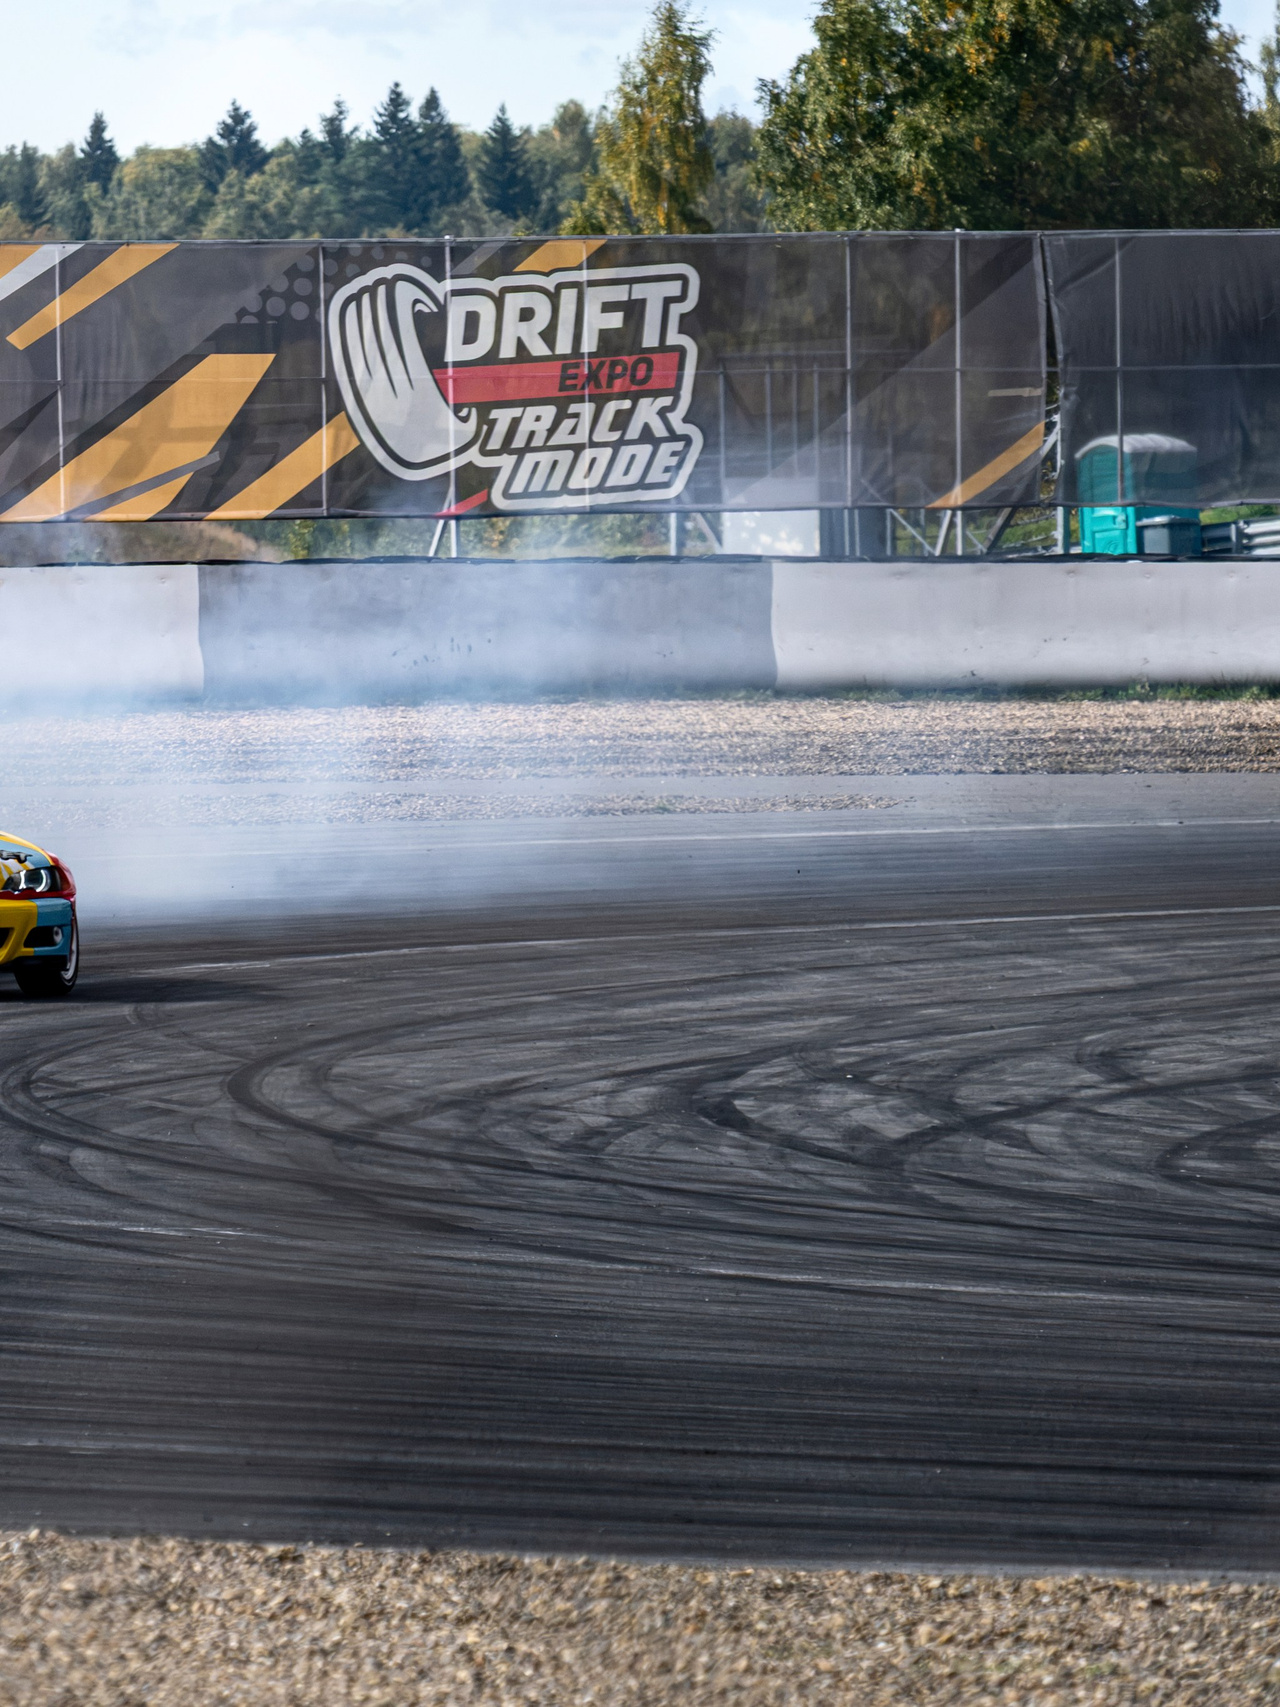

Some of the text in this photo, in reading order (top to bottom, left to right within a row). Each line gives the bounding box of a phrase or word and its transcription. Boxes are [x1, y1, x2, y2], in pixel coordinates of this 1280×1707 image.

[444, 279, 684, 363] DRIFT
[557, 355, 654, 393] EXPO
[484, 395, 675, 451] TRACK
[508, 441, 687, 495] MODE
